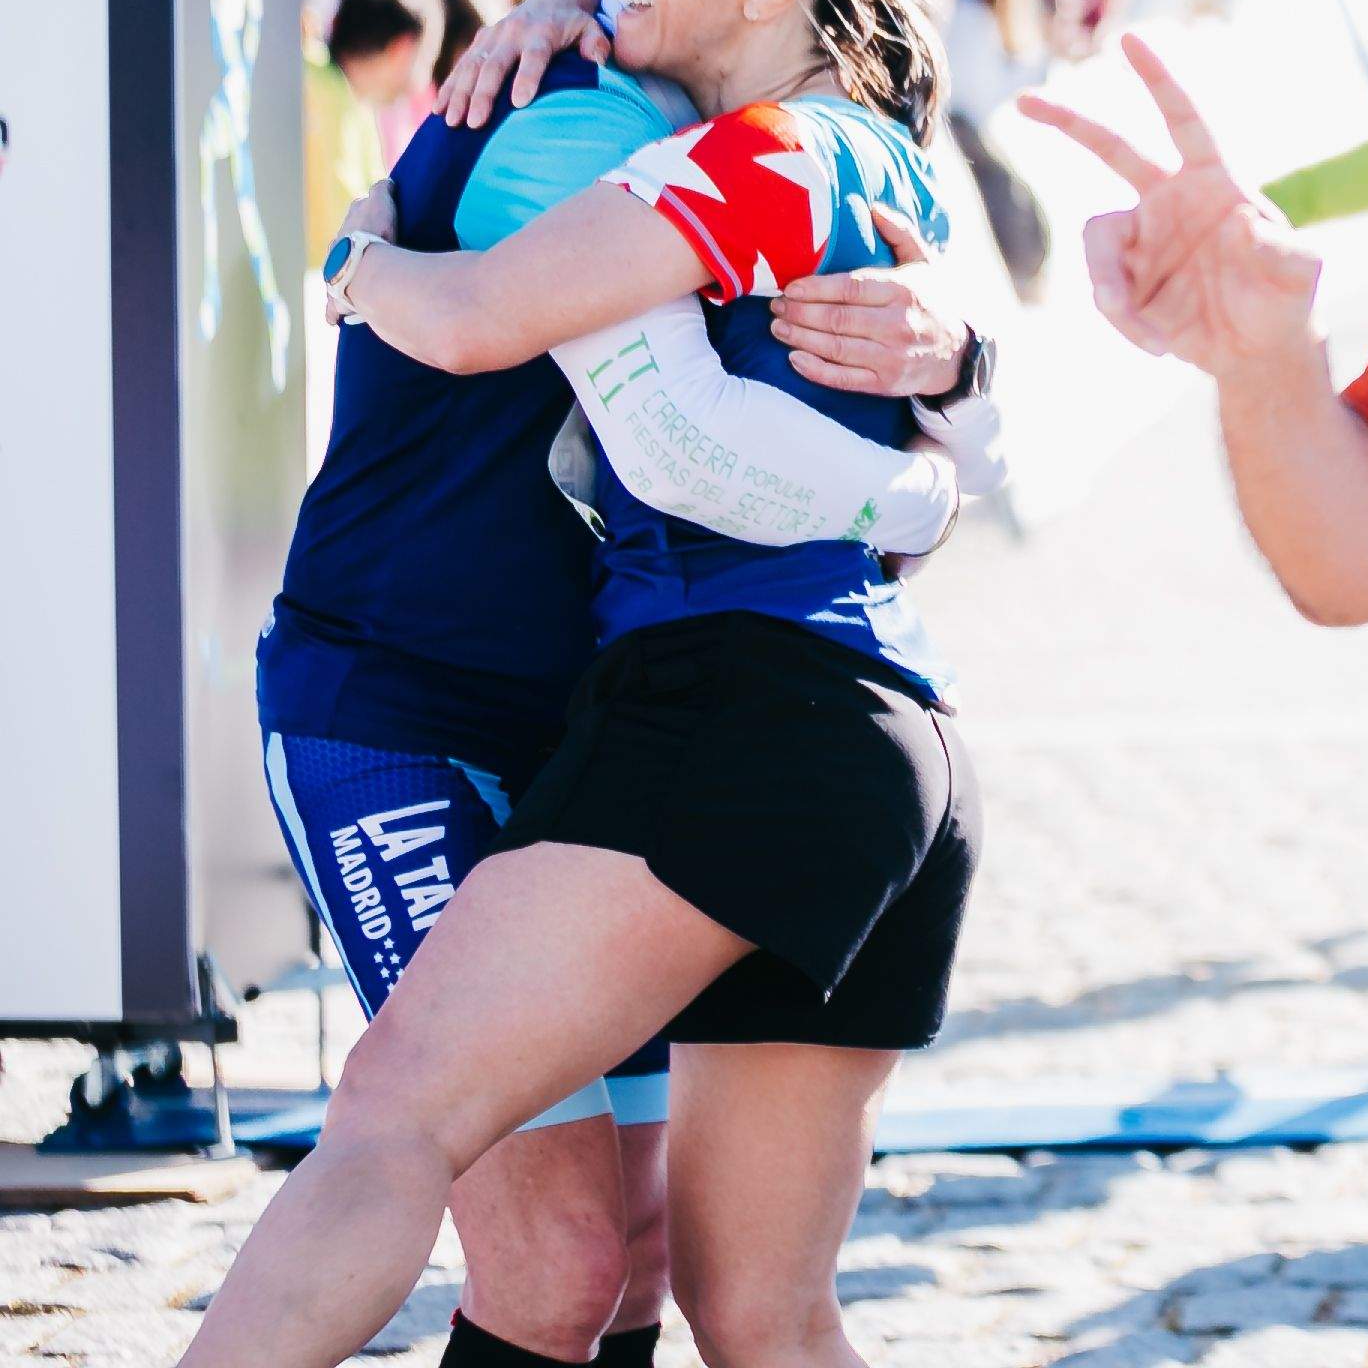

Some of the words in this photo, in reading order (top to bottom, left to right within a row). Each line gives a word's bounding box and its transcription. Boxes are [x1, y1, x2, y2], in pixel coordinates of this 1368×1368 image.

[625, 412, 690, 487] FIESTAS
[691, 478, 724, 504] DEL
[730, 493, 810, 533] SECTOR
[642, 390, 738, 479] CARRERA
[743, 465, 815, 505] POPULAR
[330, 824, 392, 939] MADRID
[357, 800, 450, 862] LA
